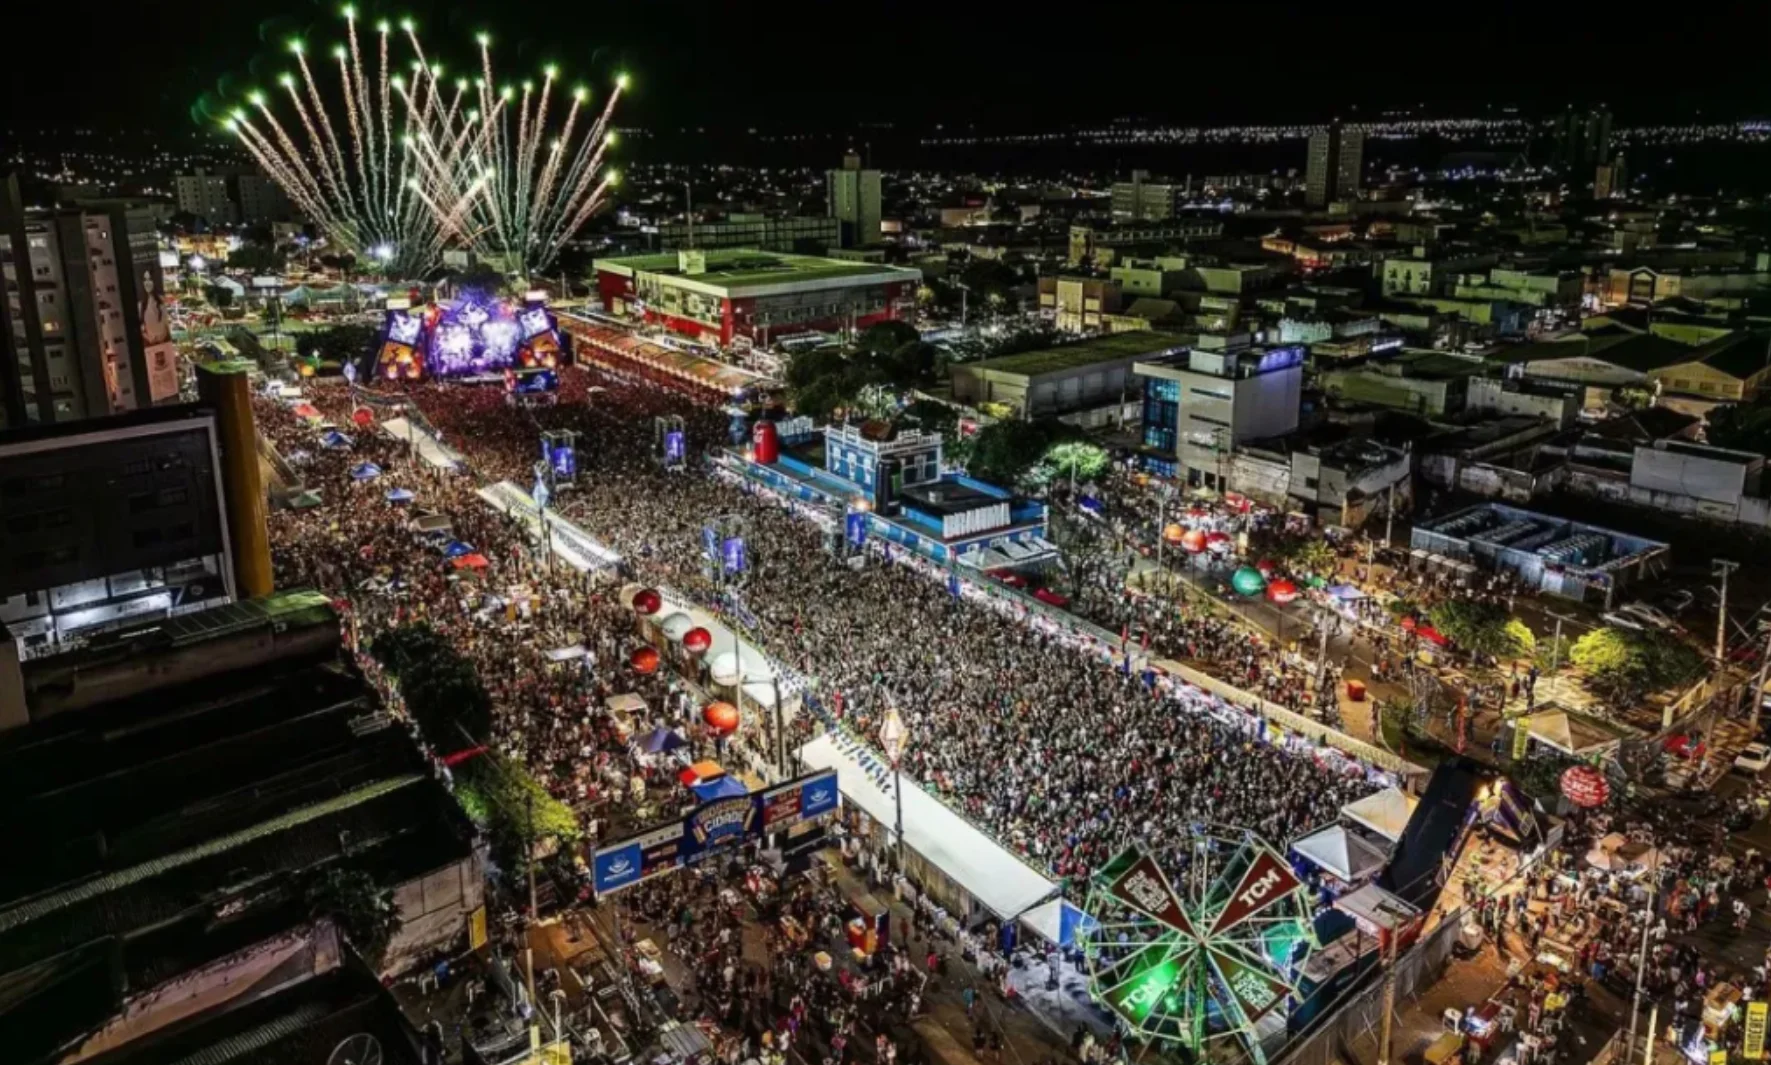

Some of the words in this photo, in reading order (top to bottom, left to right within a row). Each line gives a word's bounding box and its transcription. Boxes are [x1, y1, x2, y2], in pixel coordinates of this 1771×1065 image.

[703, 810, 744, 833] CIDADE
[1239, 868, 1281, 908] TCM
[1118, 976, 1162, 1012] TCM
